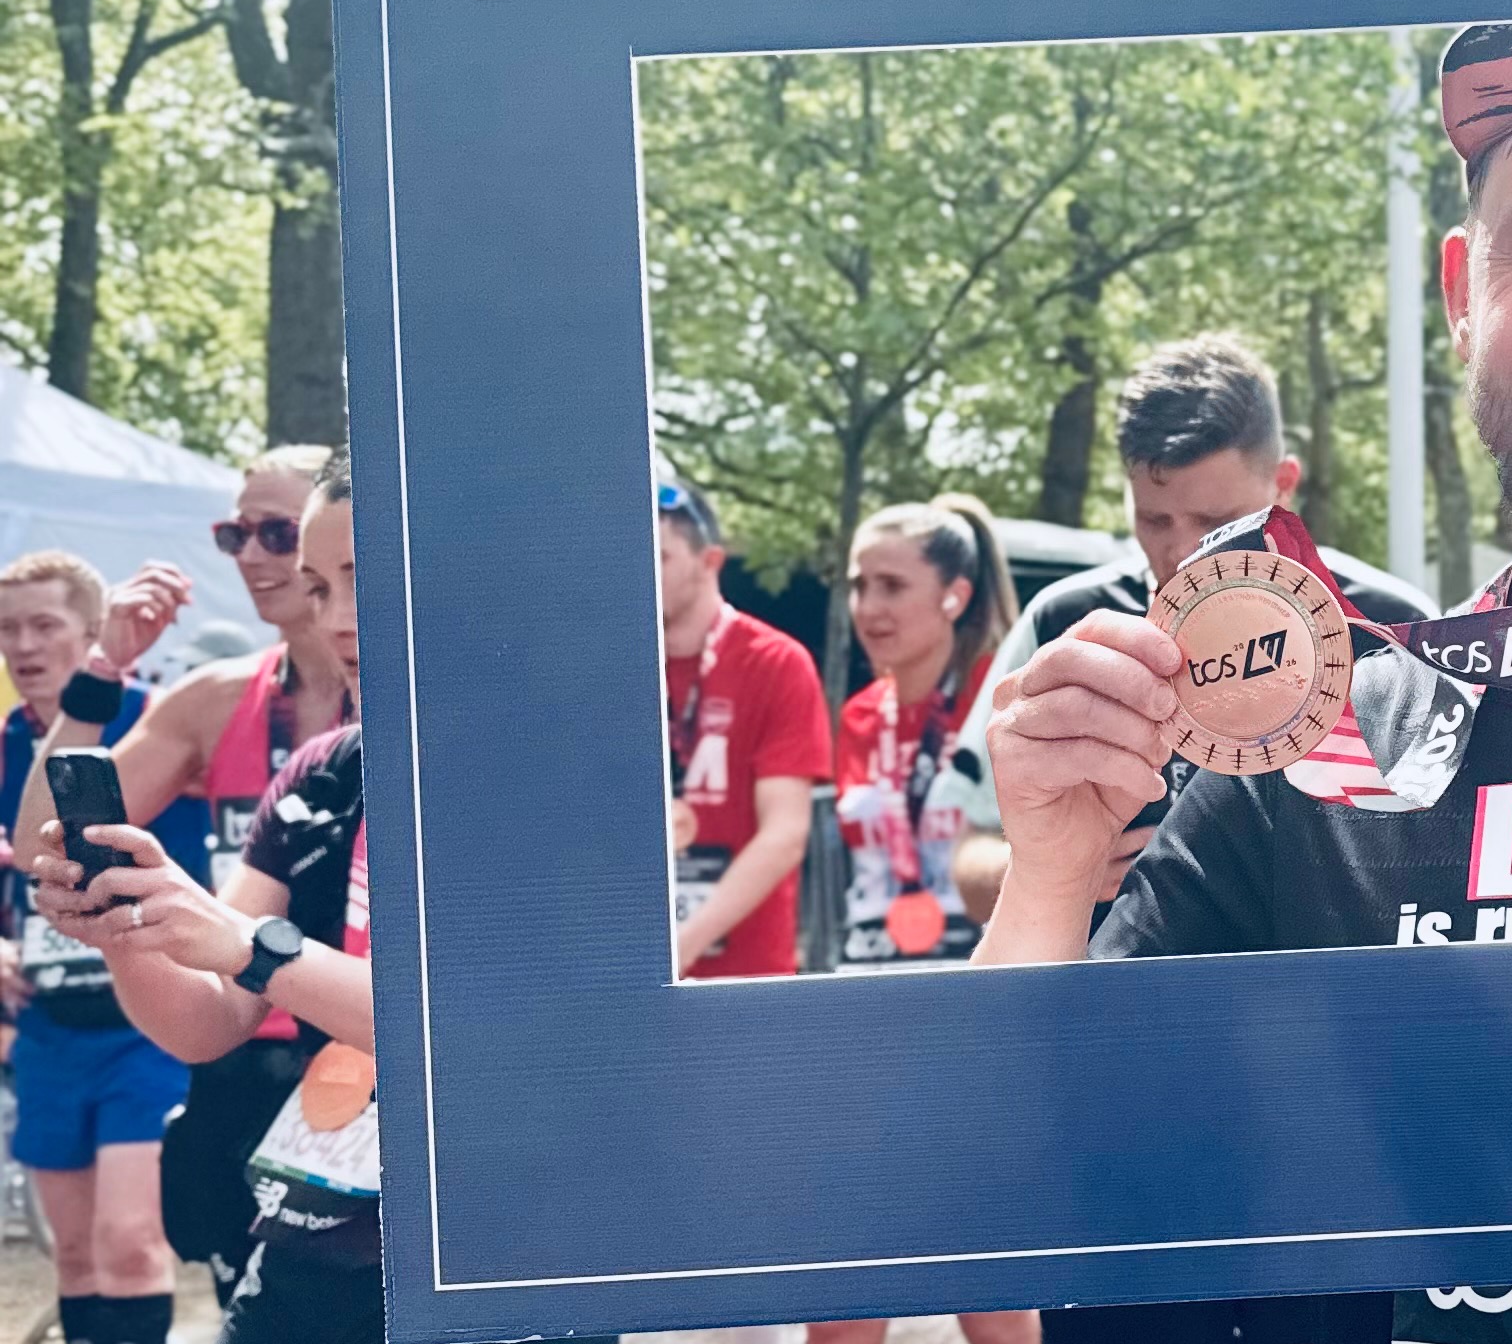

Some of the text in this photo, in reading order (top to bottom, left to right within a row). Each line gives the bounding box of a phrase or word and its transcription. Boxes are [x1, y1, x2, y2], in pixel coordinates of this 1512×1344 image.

[1187, 653, 1237, 688] tcs
[1421, 640, 1492, 674] tcs
[1396, 903, 1453, 946] is
